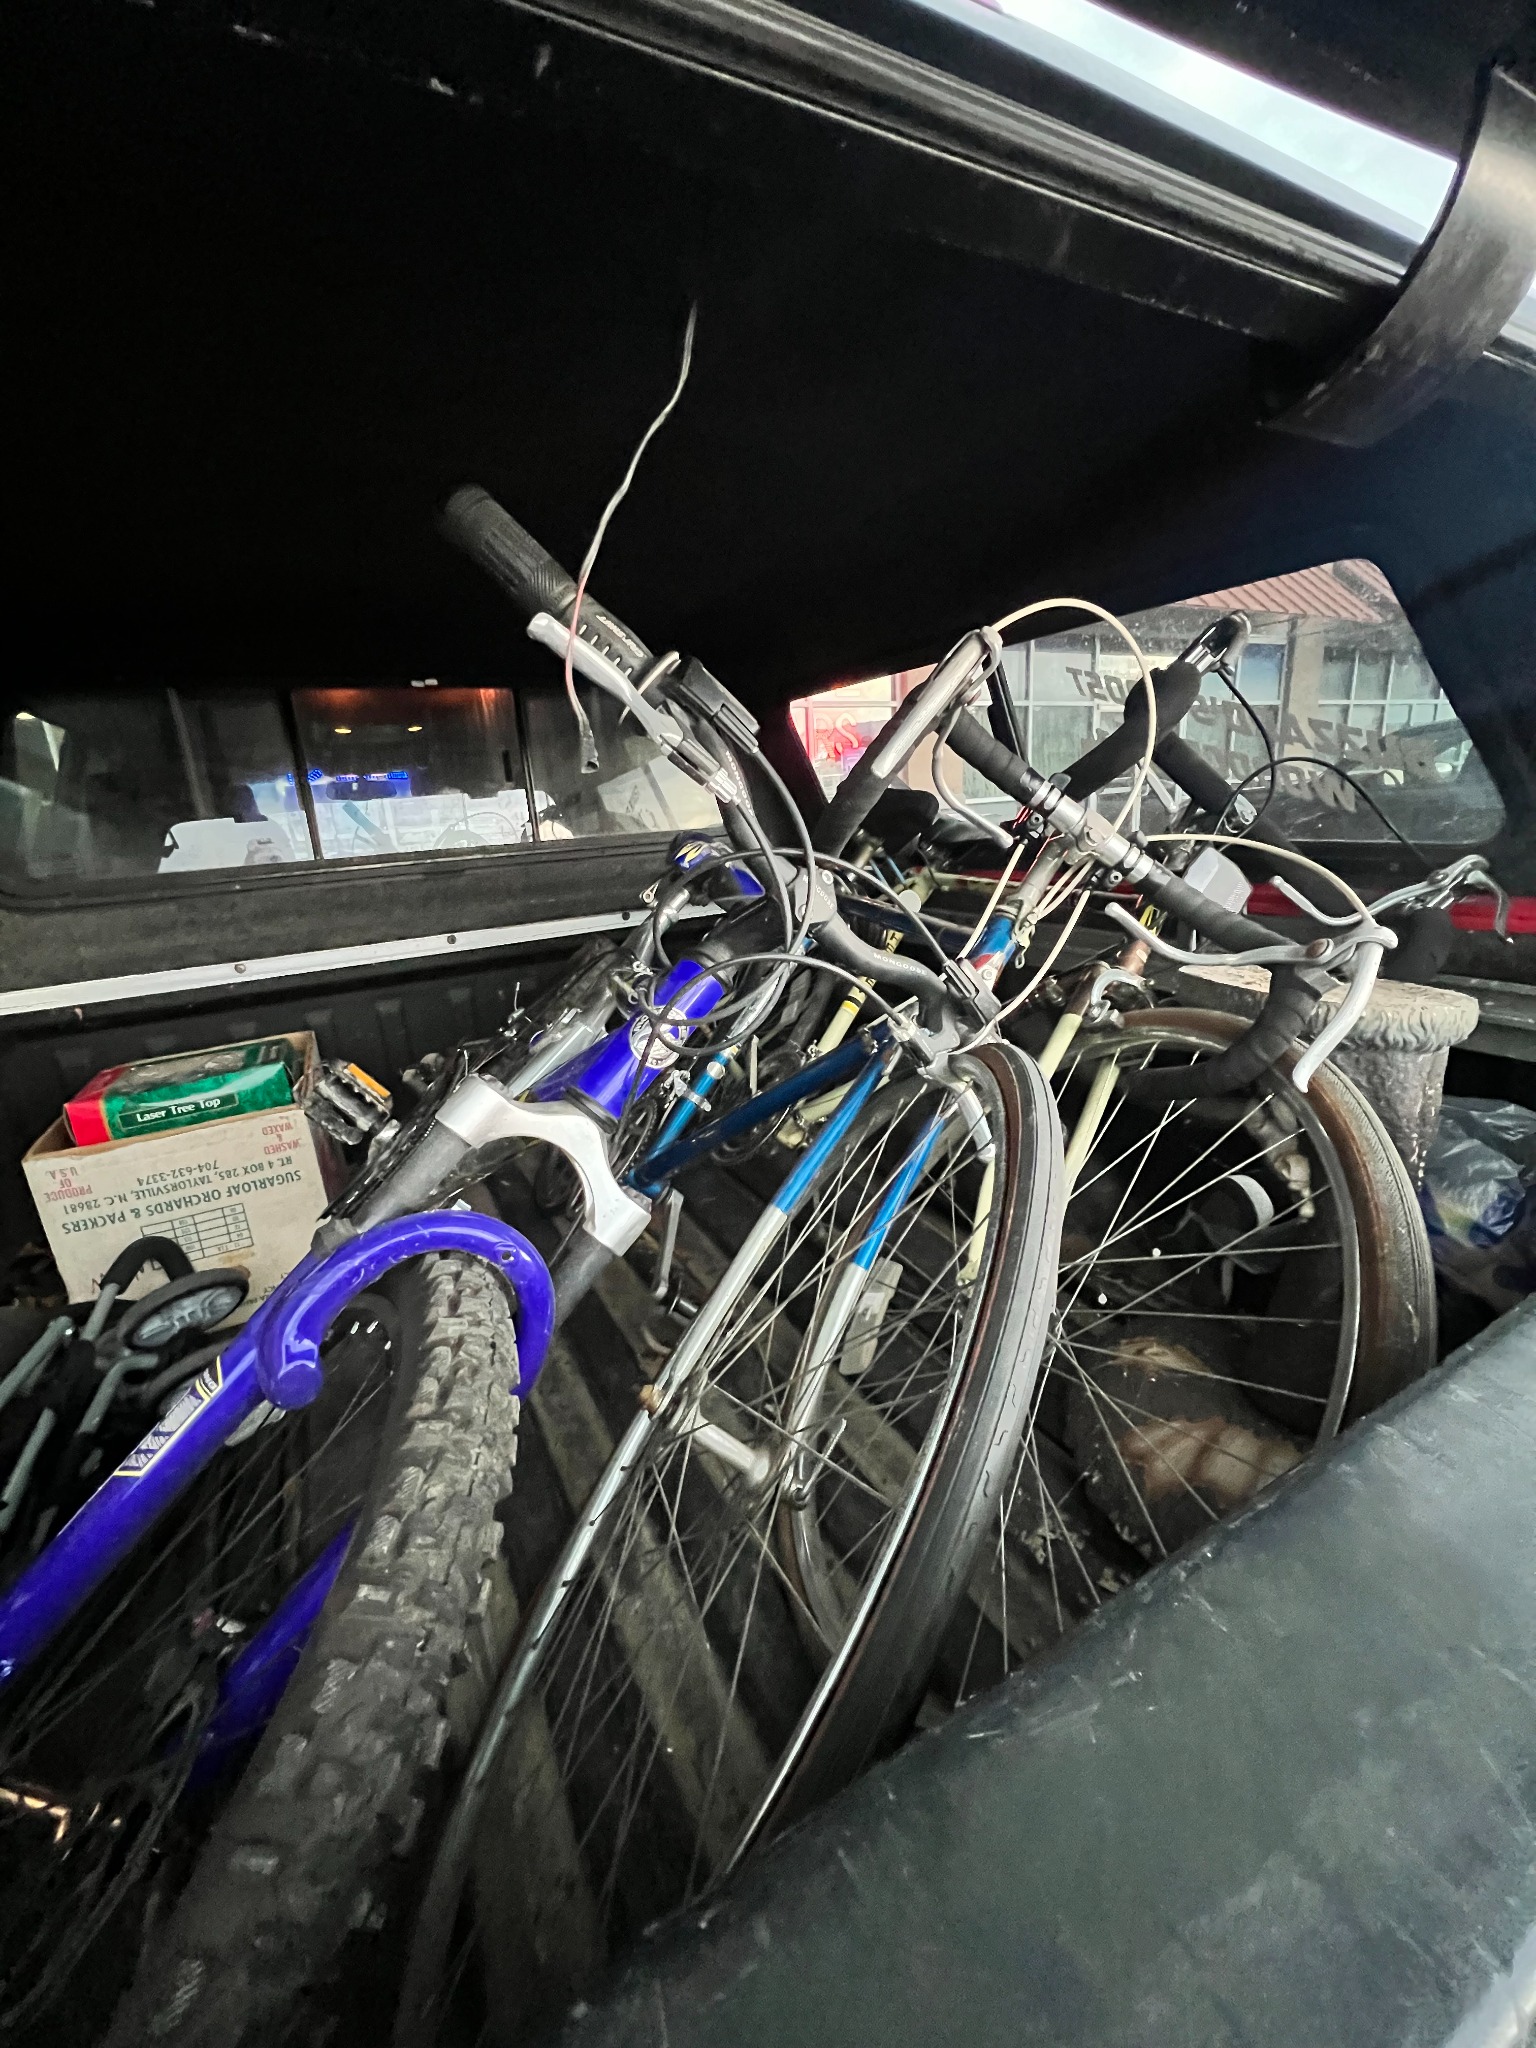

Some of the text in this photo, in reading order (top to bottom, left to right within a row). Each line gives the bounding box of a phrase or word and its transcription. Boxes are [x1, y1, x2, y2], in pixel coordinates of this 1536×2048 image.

[136, 1098, 220, 1122] Laser Tree Top
[262, 1122, 293, 1135] WAXED
[264, 1139, 300, 1155] WASHED
[242, 1162, 264, 1175] BOX
[268, 1160, 274, 1170] 4
[137, 1160, 220, 1187] 704-632-3374
[60, 1177, 72, 1189] OF
[131, 1174, 212, 1201] TAYLORSVILLE,
[44, 1184, 93, 1203] PRODUCE
[62, 1170, 302, 1235] SUGARLOAF ORCHARDS & PACKERS
[63, 1199, 100, 1215] 28681
